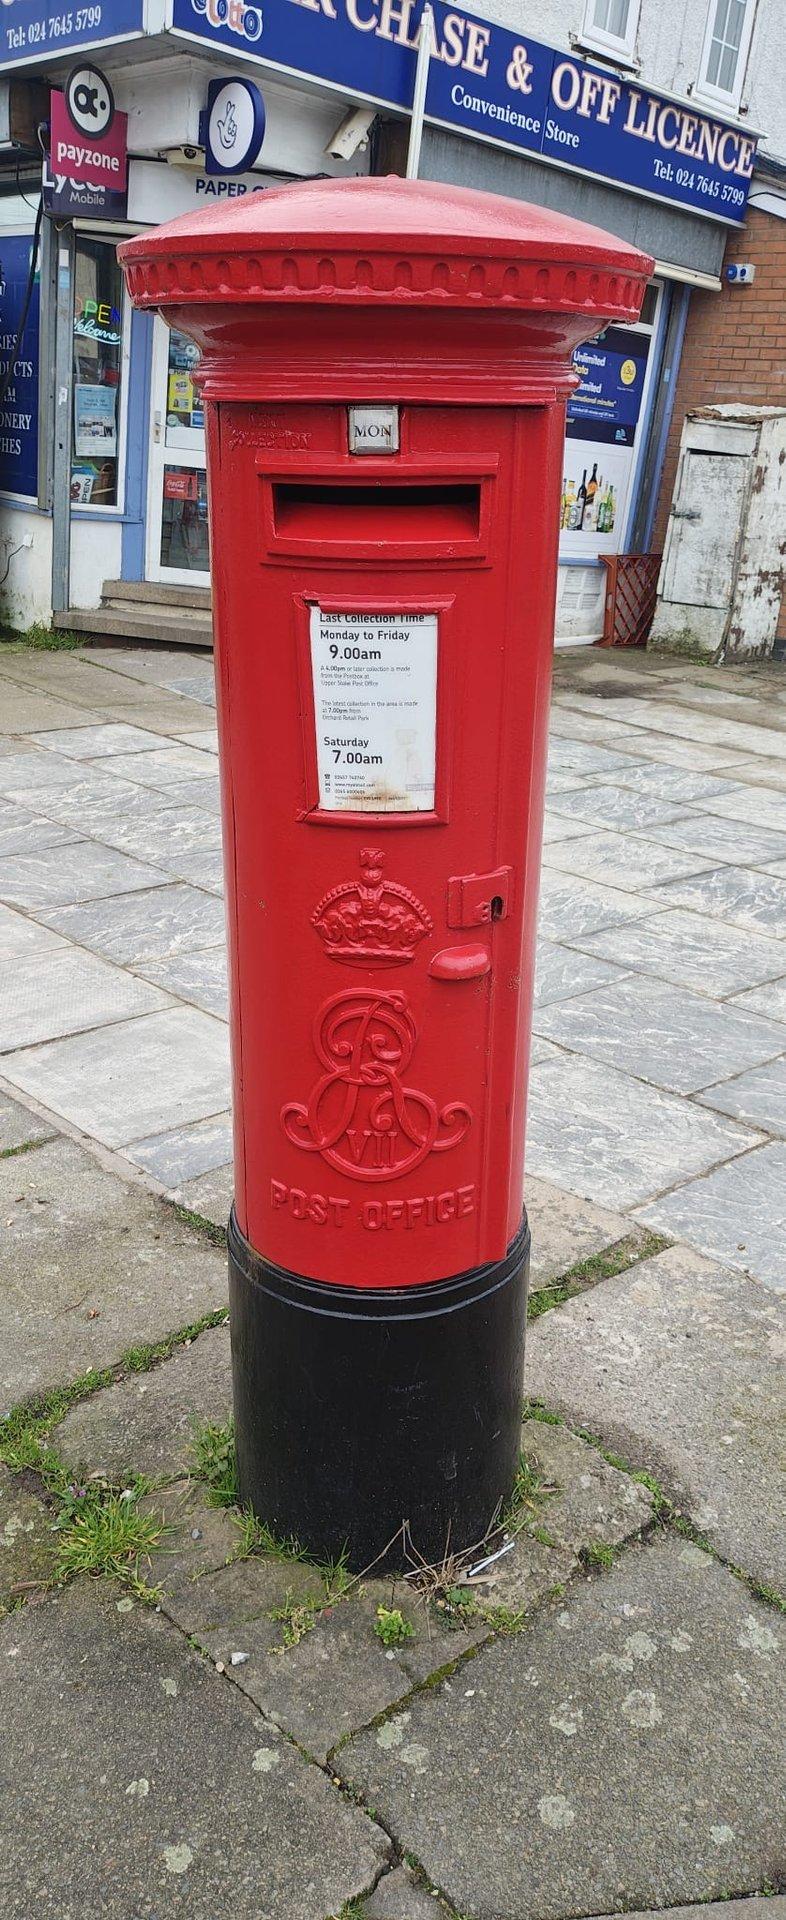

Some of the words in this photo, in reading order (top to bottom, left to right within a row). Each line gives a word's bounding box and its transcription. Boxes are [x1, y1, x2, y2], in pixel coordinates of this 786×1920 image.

[6, 26, 26, 49] Tel:
[28, 20, 46, 44] 024
[48, 13, 73, 38] 7645
[75, 5, 101, 31] 5799
[451, 84, 541, 133] Convenience
[545, 119, 580, 148] Store
[506, 45, 533, 94] &
[551, 62, 621, 124] OFF
[622, 88, 756, 178] LICENCE
[57, 142, 120, 171] payzone
[195, 178, 247, 197] PAPER
[653, 158, 674, 182] Tel:
[676, 168, 695, 189] 024
[697, 175, 721, 197] 7645
[721, 185, 745, 206] 5799
[70, 192, 105, 205] Mobile
[573, 350, 607, 367] Unlimited
[353, 424, 392, 438] MON
[319, 613, 342, 623] Last
[344, 613, 396, 624] Collection
[400, 614, 425, 623] Time
[320, 630, 360, 642] Monday
[363, 631, 374, 640] to
[378, 630, 410, 642] Friday
[329, 644, 382, 660] 9.00am
[323, 736, 370, 749] Saturday
[332, 749, 383, 765] 7.00am
[345, 1129, 398, 1167] VII
[271, 1178, 351, 1227] POST
[362, 1184, 476, 1230] OFFICE
